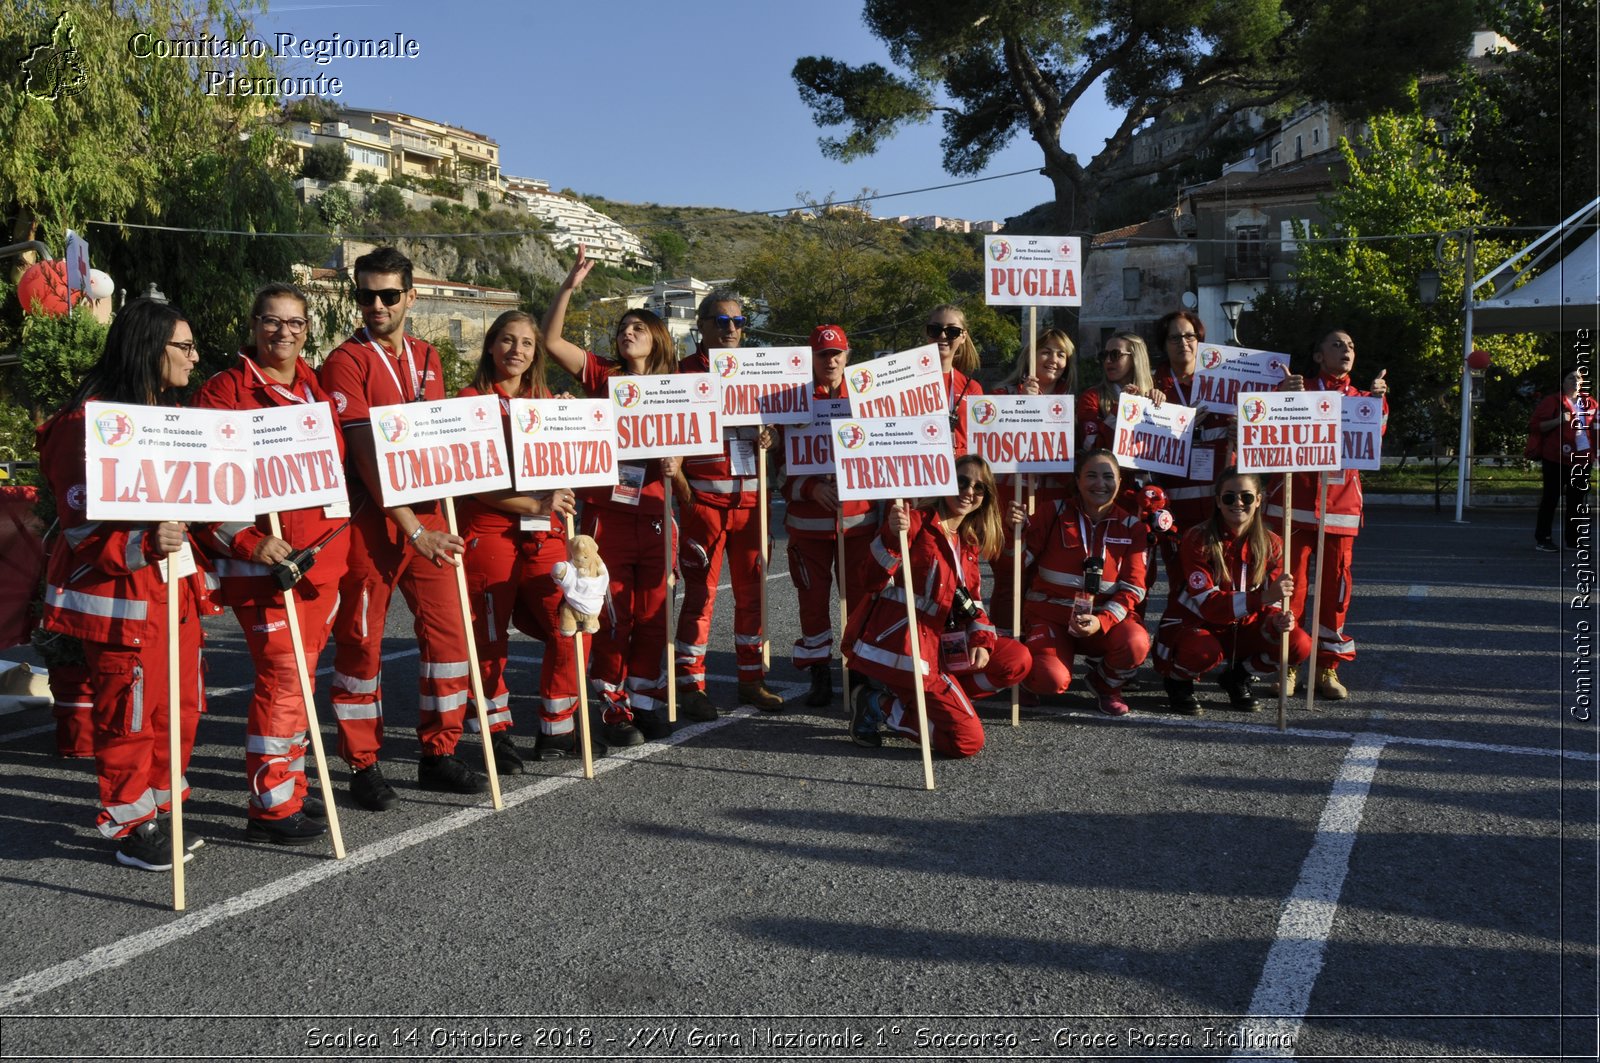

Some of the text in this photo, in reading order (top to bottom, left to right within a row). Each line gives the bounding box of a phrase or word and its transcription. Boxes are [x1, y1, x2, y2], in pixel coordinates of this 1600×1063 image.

[991, 268, 1076, 296] PUGLIA
[900, 382, 944, 416] ADIGE
[164, 427, 203, 436] Nazionale
[431, 416, 461, 424] Nazionale
[617, 412, 718, 449] SICILIA 1
[1243, 424, 1336, 445] FRIULI
[173, 440, 207, 448] Soccorso
[262, 437, 293, 445] Soccorso
[973, 432, 1070, 463] TOSCANA
[1118, 428, 1186, 466] BASILICATA
[1243, 446, 1336, 468] VENEZIA GIULIA
[385, 439, 504, 492] UMBRIA
[521, 440, 612, 477] ABRUZZO
[841, 454, 950, 489] TRENTINO
[100, 458, 246, 505] LAZIO
[254, 450, 338, 500] MONTE
